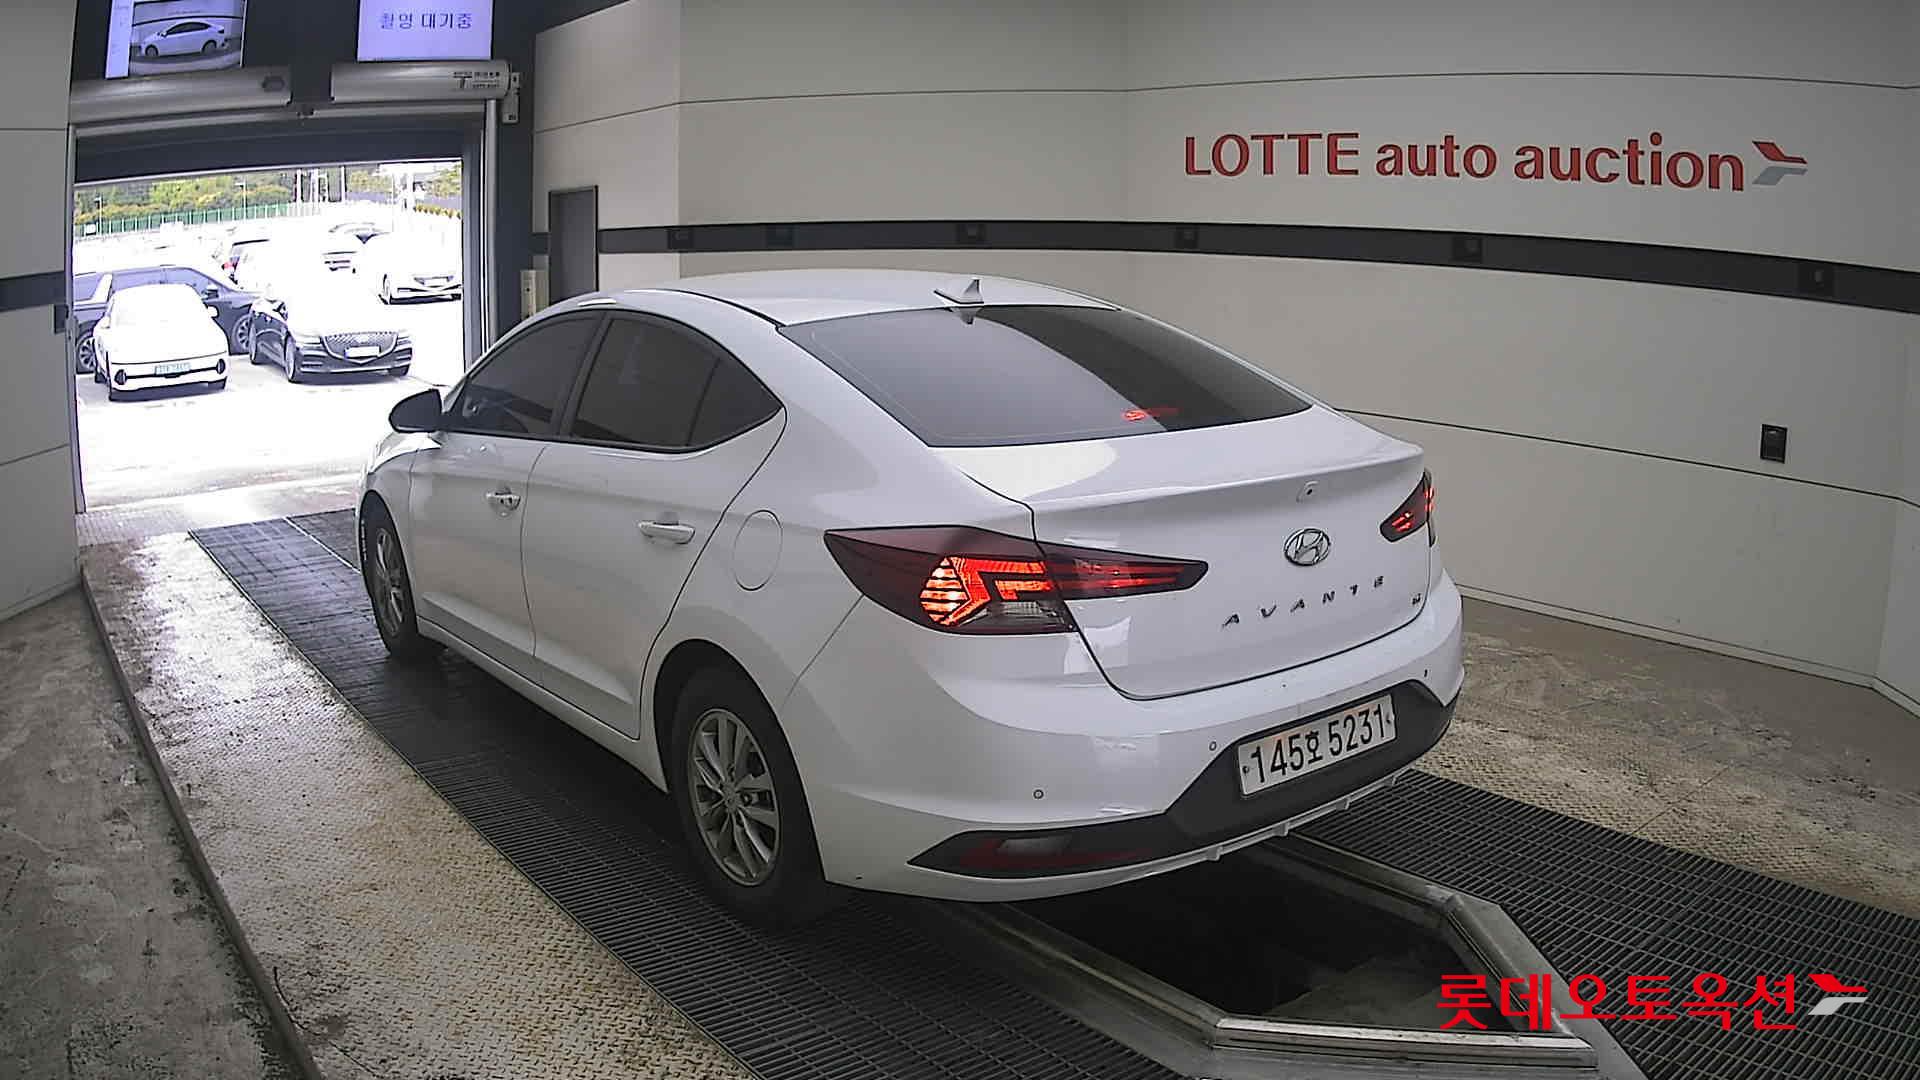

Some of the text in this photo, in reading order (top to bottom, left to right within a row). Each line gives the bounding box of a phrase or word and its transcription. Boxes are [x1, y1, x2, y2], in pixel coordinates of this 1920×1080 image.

[421, 13, 472, 29] 대기중
[1185, 132, 1745, 192] LOTTE auto auction
[1221, 575, 1385, 629] AVANTE
[1250, 704, 1385, 783] 145호 5231
